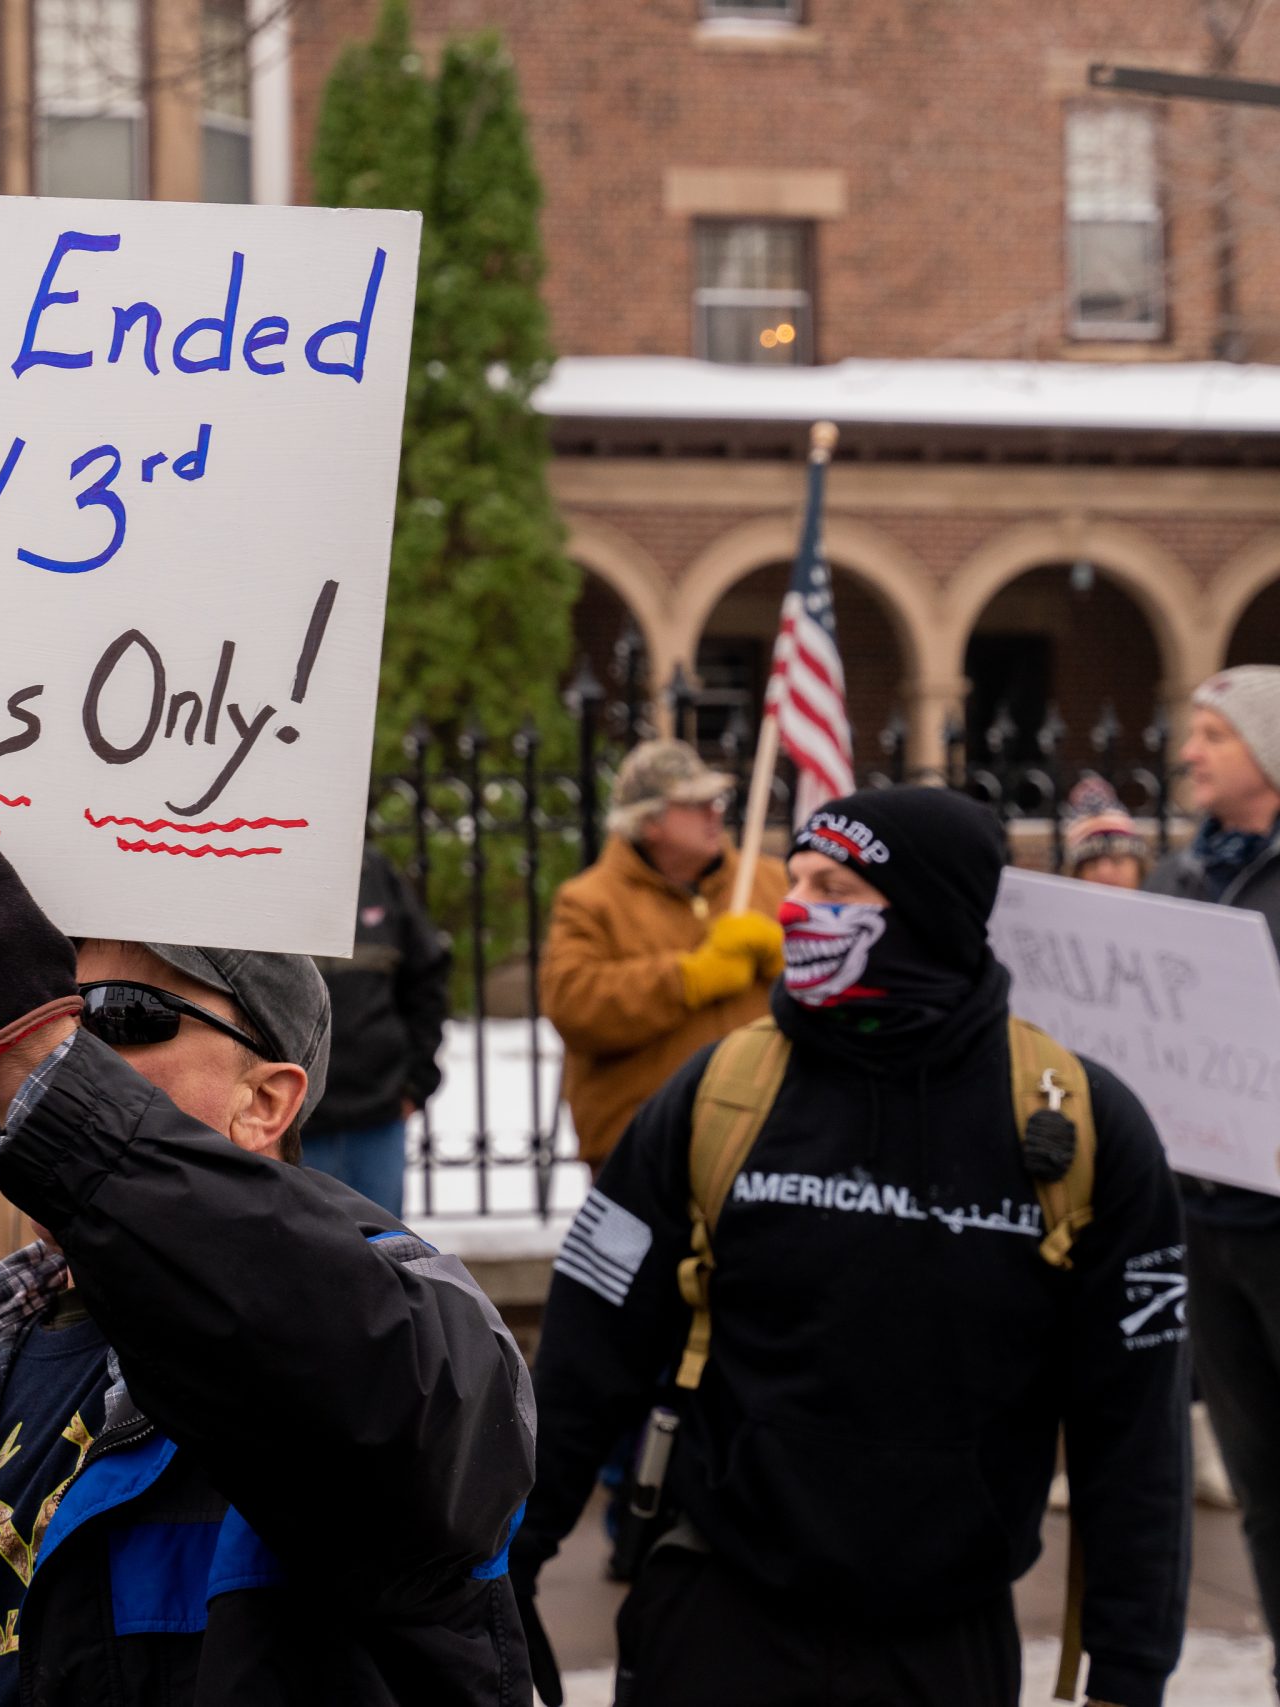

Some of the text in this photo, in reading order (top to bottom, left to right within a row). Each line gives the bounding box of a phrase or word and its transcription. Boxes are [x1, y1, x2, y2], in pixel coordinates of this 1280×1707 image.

[11, 231, 386, 382] Ended
[15, 424, 212, 574] 3rd
[83, 580, 339, 816] Only!
[1195, 1033, 1280, 1101] 202
[733, 1171, 910, 1217] AMERICAN
